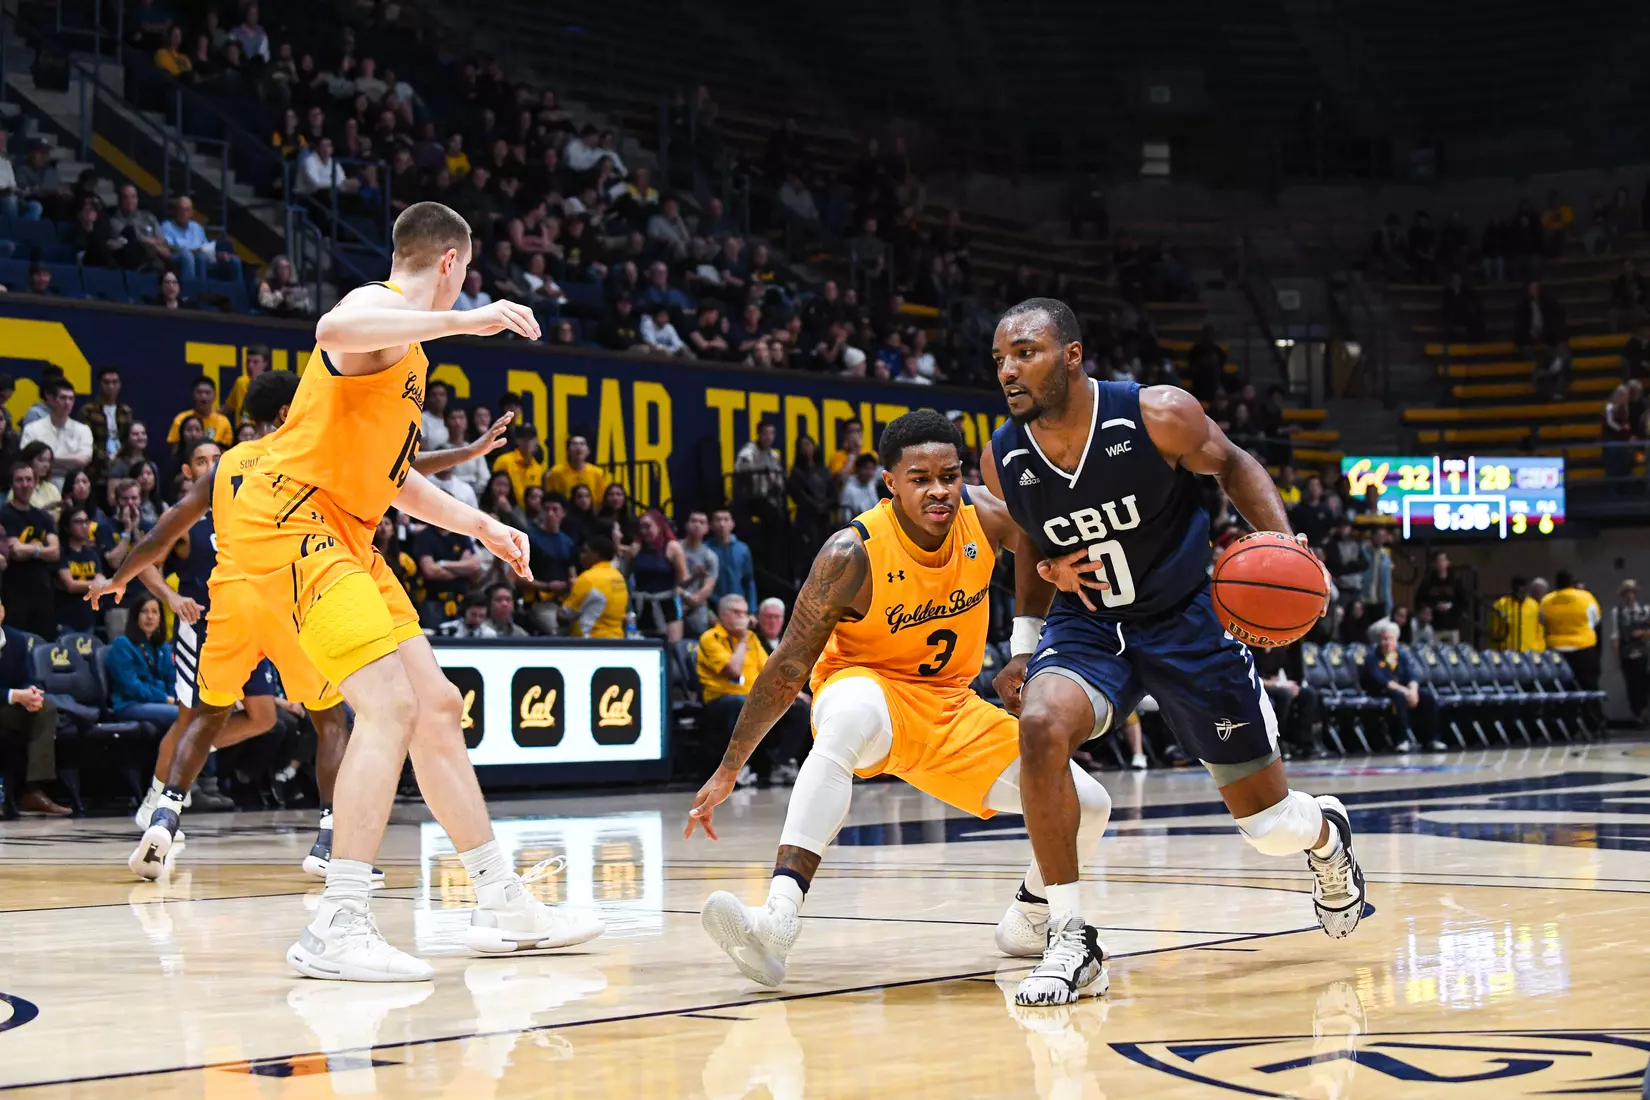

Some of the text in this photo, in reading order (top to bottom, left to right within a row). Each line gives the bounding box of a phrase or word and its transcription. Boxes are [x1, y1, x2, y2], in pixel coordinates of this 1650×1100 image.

[389, 421, 421, 488] 15
[1105, 440, 1132, 457] WAC
[1019, 477, 1041, 486] adidas
[1399, 465, 1430, 490] 32
[1479, 465, 1511, 490] 28
[1448, 472, 1460, 494] 1
[1043, 494, 1141, 546] CBU
[1512, 513, 1527, 534] 3
[1539, 513, 1554, 534] 6
[1088, 539, 1136, 608] 0
[885, 599, 948, 634] Golden
[51, 647, 71, 666] Cal
[76, 637, 92, 654] Cal
[918, 629, 958, 676] 3
[520, 684, 557, 728] Cal
[598, 684, 634, 727] Cal
